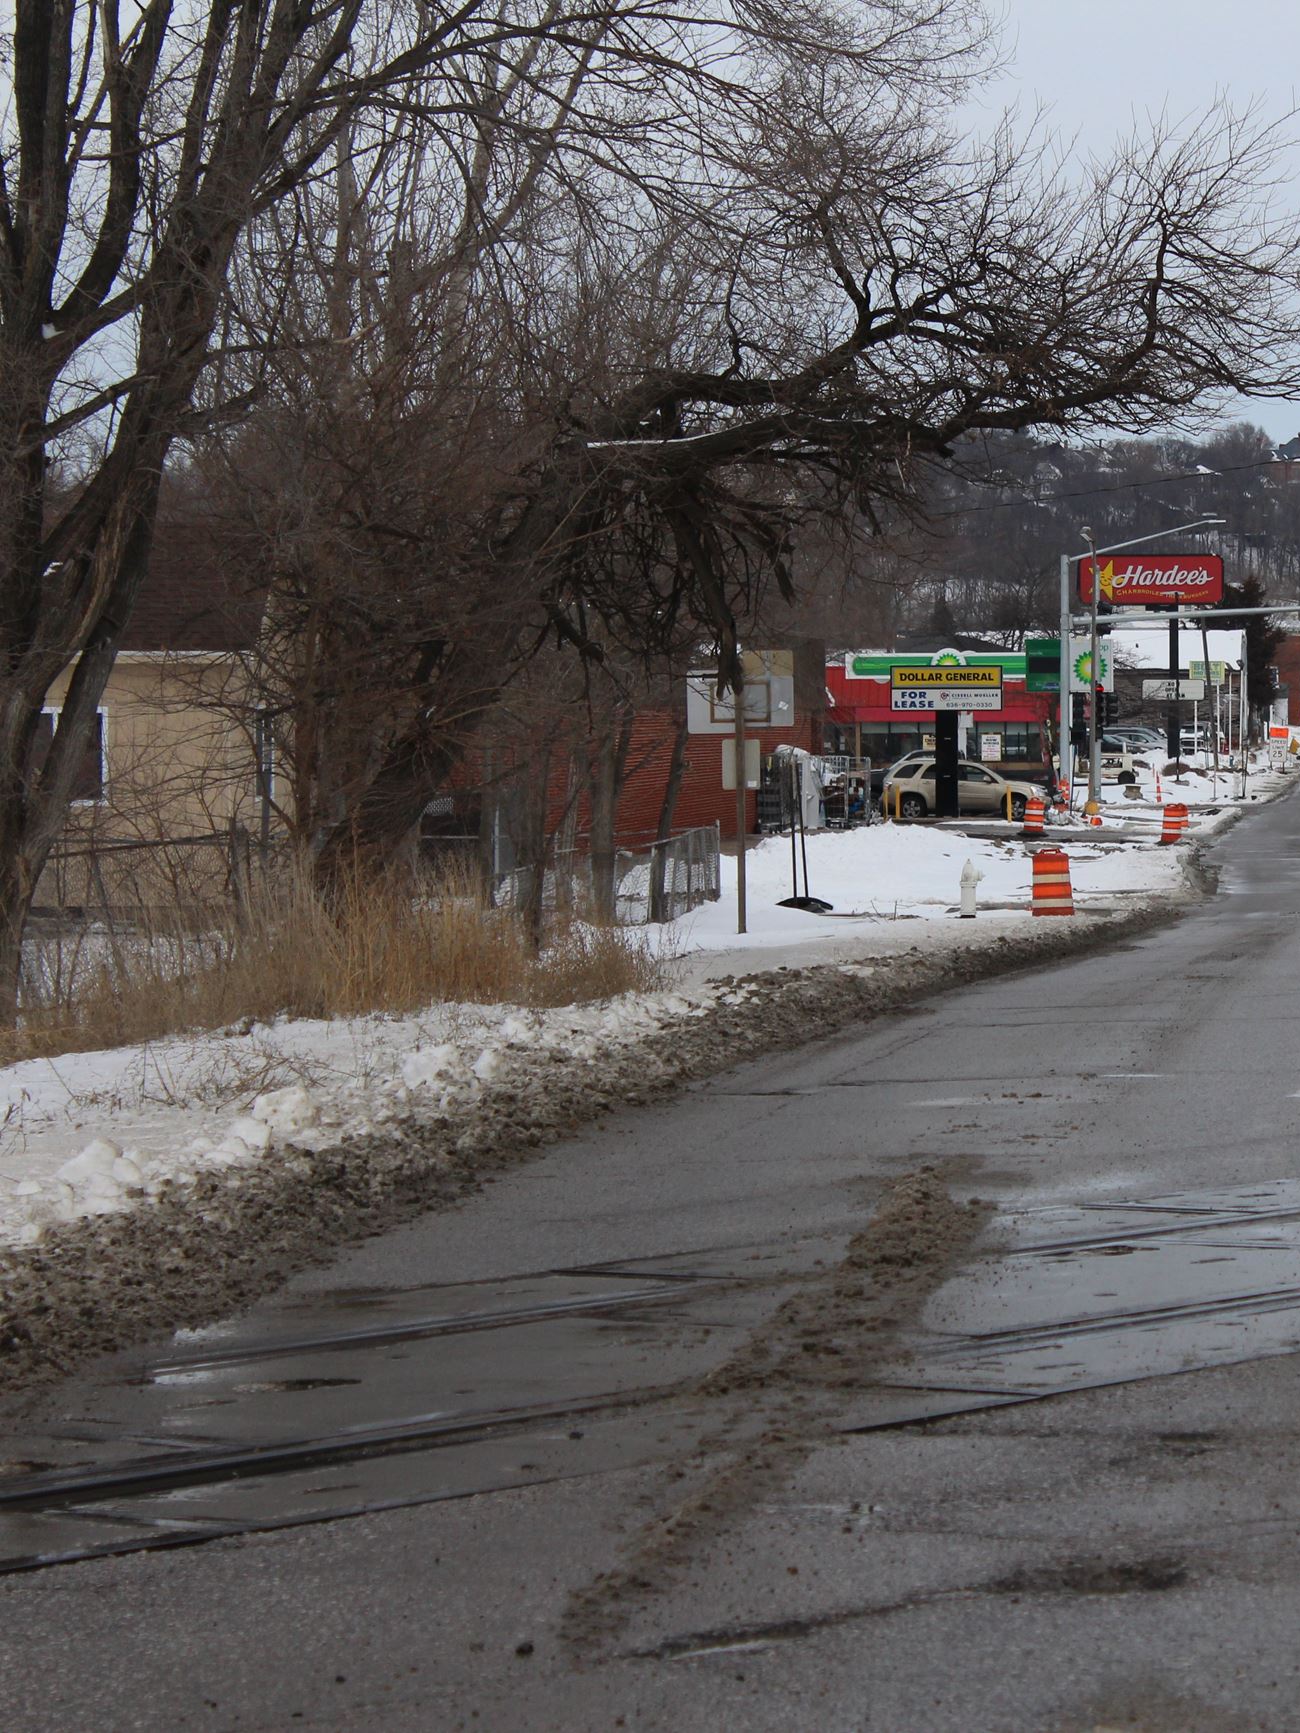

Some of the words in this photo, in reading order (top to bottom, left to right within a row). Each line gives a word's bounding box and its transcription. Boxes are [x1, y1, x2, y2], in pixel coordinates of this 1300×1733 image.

[1111, 565, 1215, 588] Hardee's
[899, 673, 942, 681] DOLLAR
[945, 673, 994, 681] GENERAL
[901, 691, 927, 699] FOR
